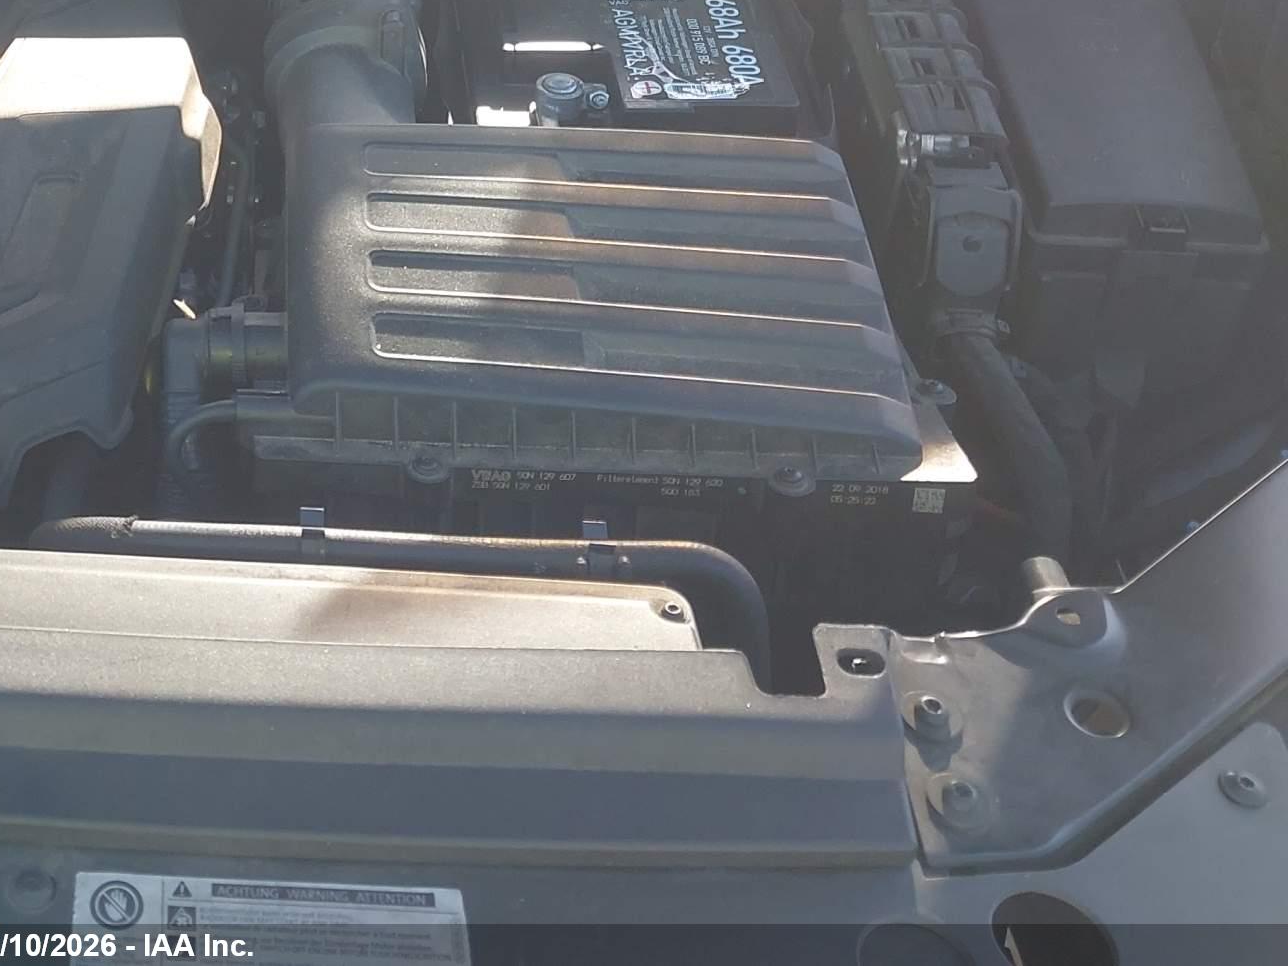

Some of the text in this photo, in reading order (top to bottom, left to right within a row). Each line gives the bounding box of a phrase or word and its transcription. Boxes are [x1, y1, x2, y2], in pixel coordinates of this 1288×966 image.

[721, 44, 766, 87] 680A
[215, 885, 427, 906] ACHTUNG WARNING ATTENTION
